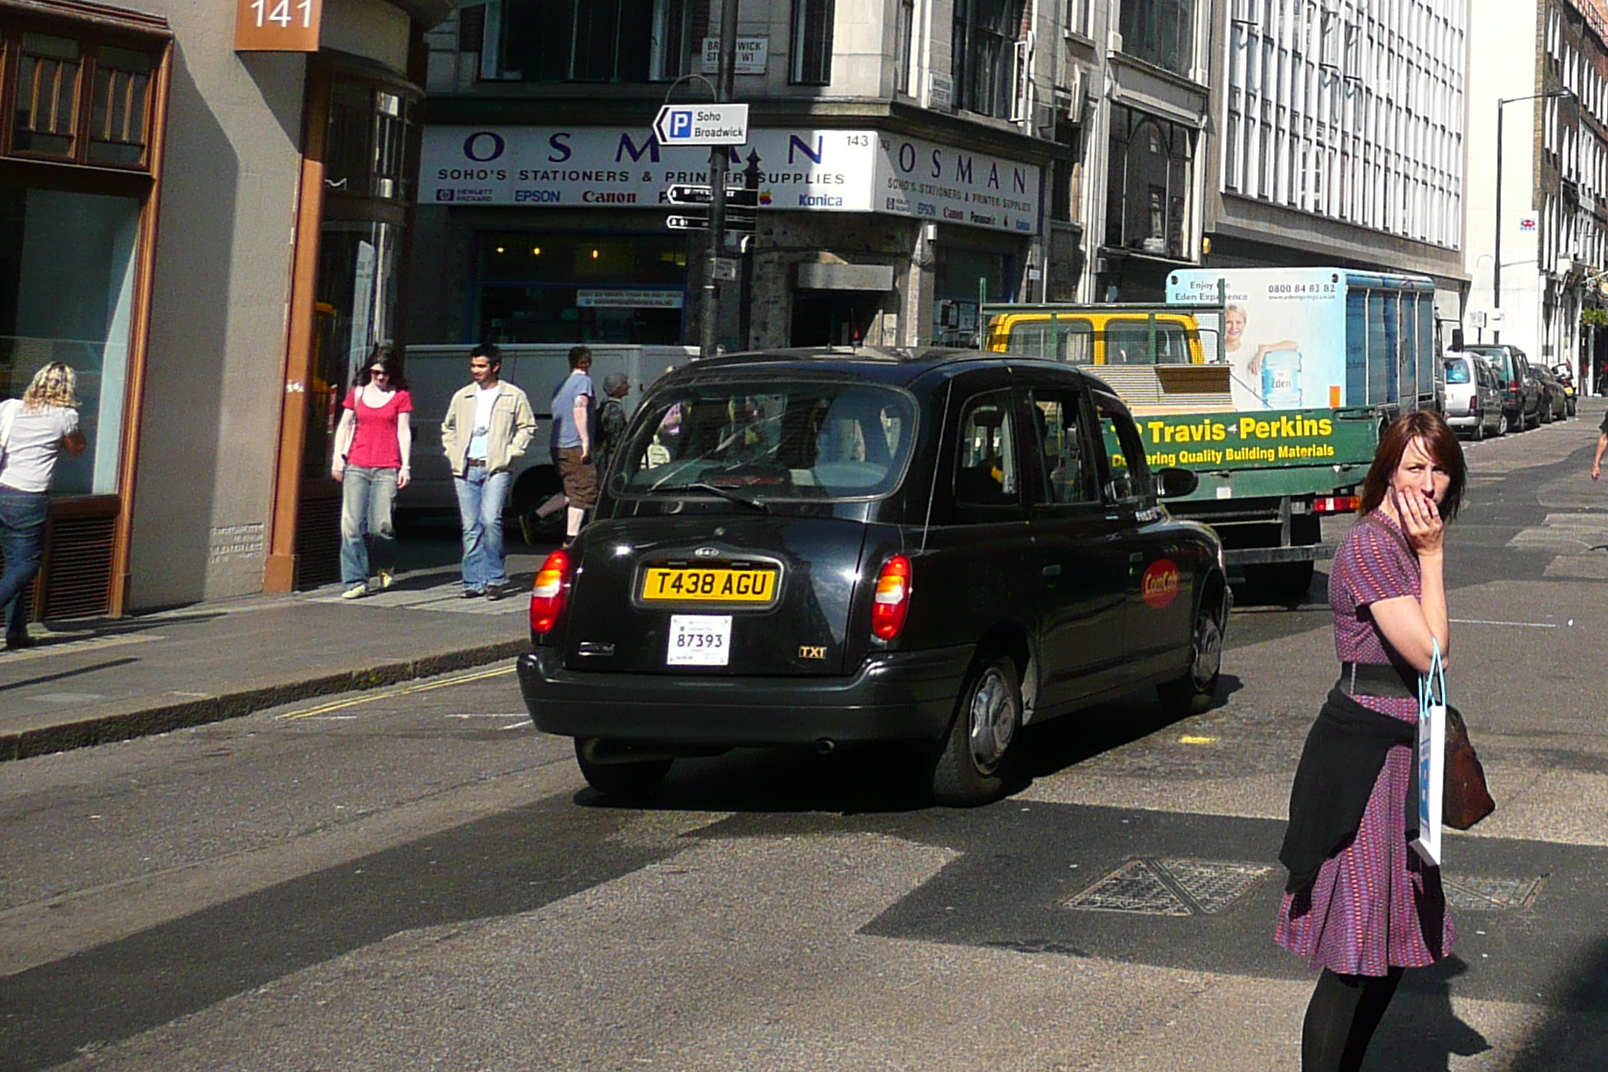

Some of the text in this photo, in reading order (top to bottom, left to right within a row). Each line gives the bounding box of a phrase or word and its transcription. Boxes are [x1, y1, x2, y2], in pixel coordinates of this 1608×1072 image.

[707, 41, 762, 51] BRWICK
[742, 52, 755, 62] W1
[697, 111, 721, 121] Soho
[694, 127, 744, 138] Broadwick
[846, 135, 869, 146] 143
[463, 131, 823, 165] OSMN
[899, 142, 1026, 195] OSMAN
[438, 169, 845, 184] SOHO'S STATIONERS & PRINER SUPPLIES
[515, 190, 637, 203] EPSON Canon
[798, 193, 843, 206] Konica
[918, 182, 962, 201] STATIONERS
[972, 193, 1000, 207] PRINTER
[1003, 198, 1032, 213] SUPPLIES
[1190, 281, 1214, 290] Enjoy
[1268, 284, 1292, 293] 0800
[1175, 292, 1197, 301] Eden
[1148, 419, 1226, 444] Travis
[1239, 415, 1332, 440] Perkins
[1179, 448, 1223, 464] Quality
[1226, 446, 1276, 461] Building
[1278, 444, 1335, 459] Materials
[657, 572, 767, 595] T438 AGU
[677, 633, 723, 648] 87393
